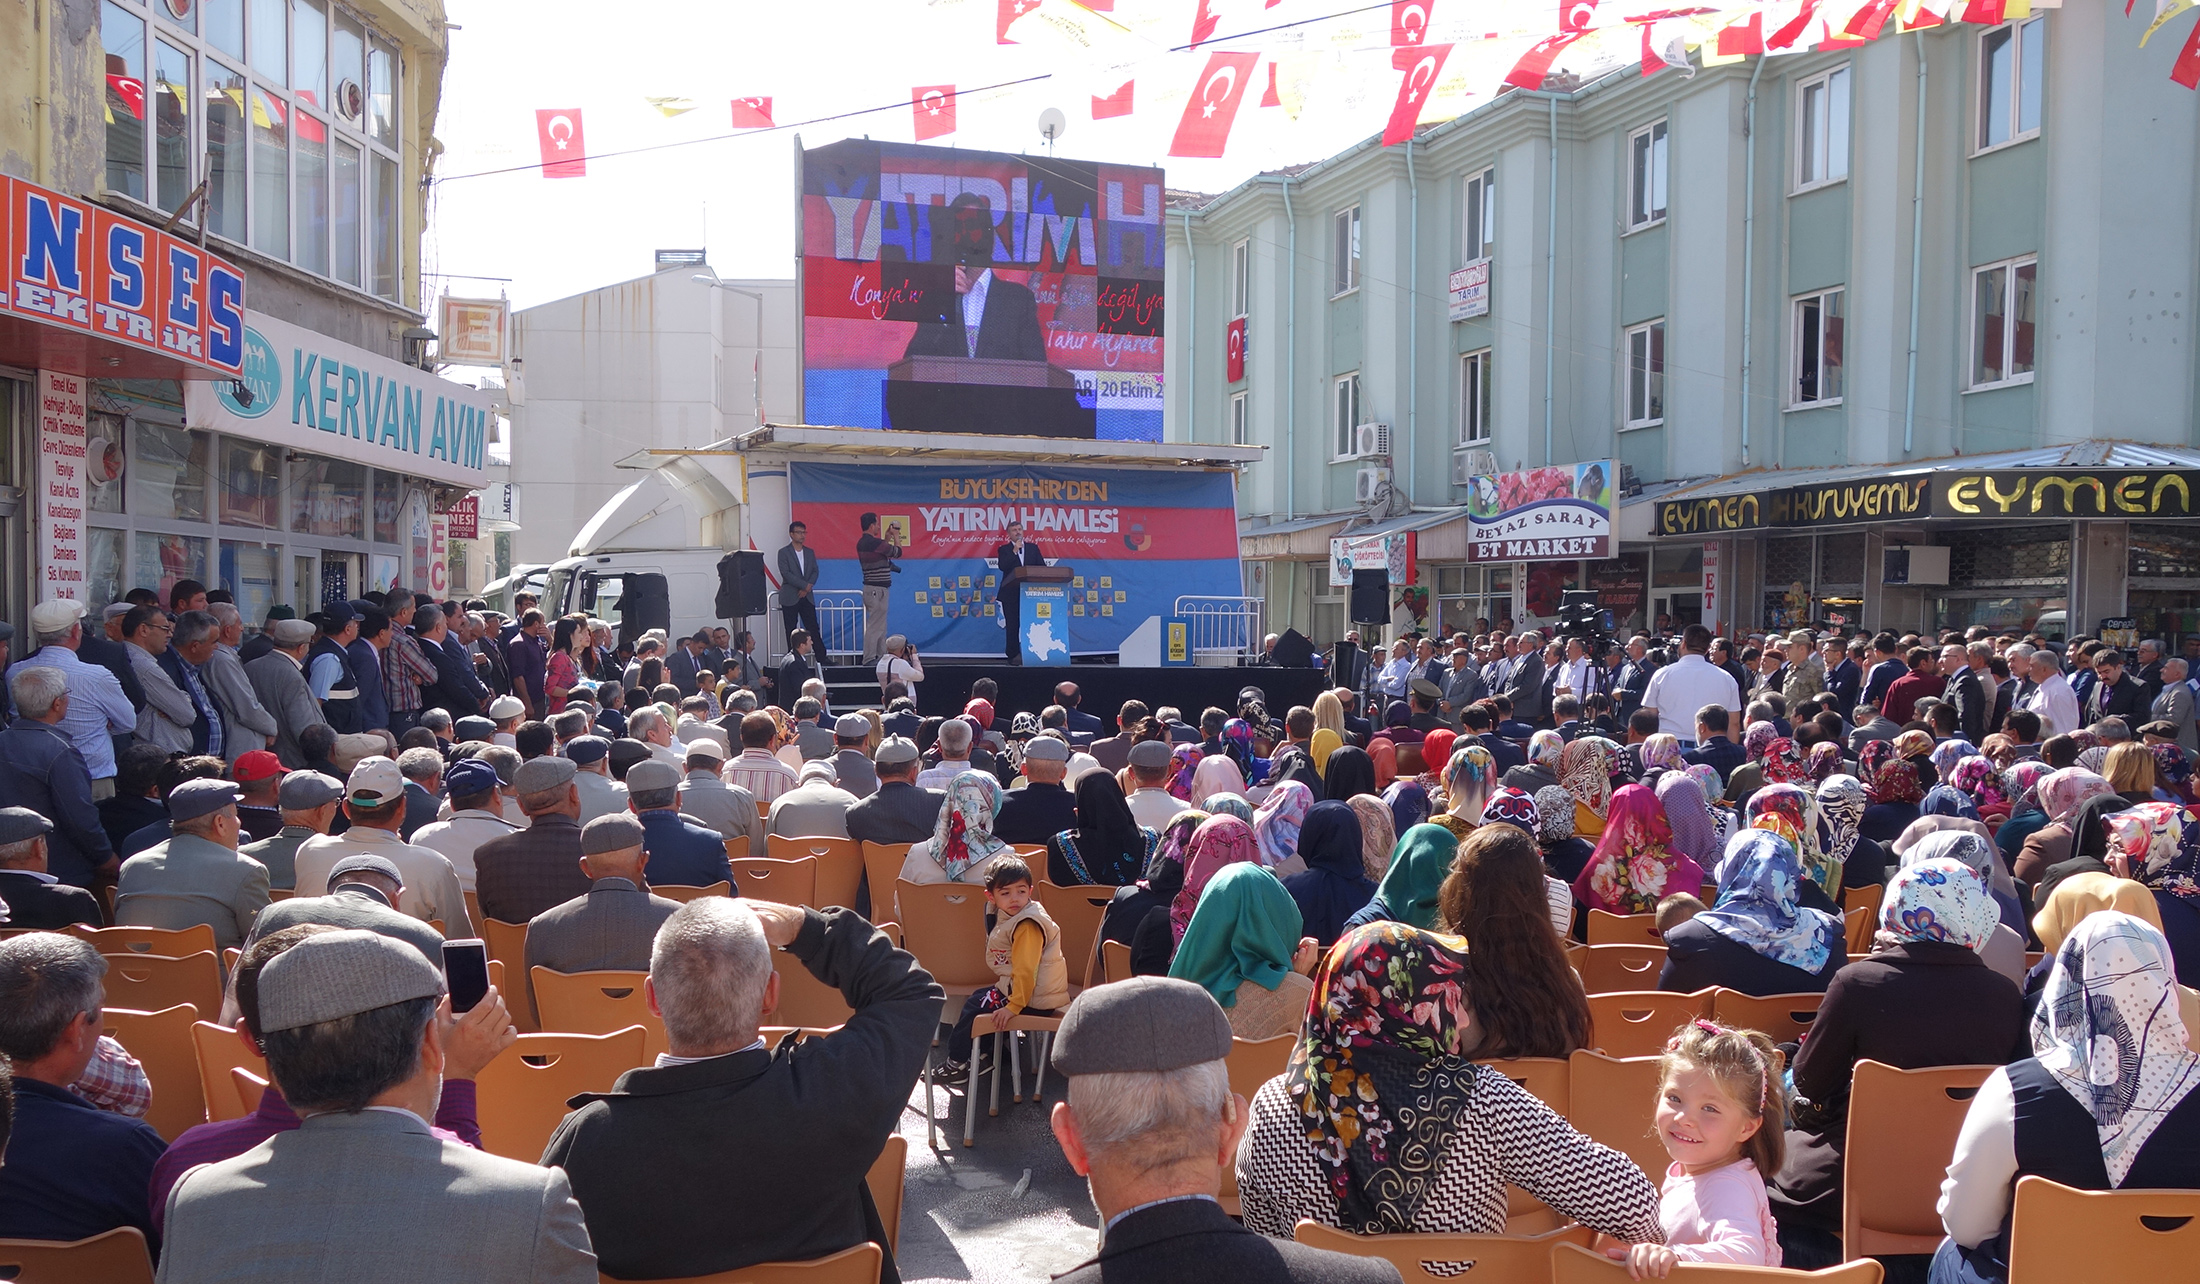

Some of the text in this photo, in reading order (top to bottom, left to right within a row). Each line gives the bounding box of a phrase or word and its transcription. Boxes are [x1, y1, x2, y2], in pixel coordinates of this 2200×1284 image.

[22, 190, 244, 370] NSES
[1457, 287, 1480, 301] TARIM
[1046, 319, 1088, 349] Tahir
[49, 375, 66, 394] Temel
[1101, 381, 1118, 398] 20
[1120, 381, 1153, 399] Ekim
[43, 395, 66, 416] Hafriyat
[68, 399, 84, 420] Dolgu
[292, 347, 486, 471] KERVAN AVM
[43, 416, 85, 438] Çiftlik Temizleme
[42, 437, 86, 459] Çevre Düzenleme
[54, 460, 75, 481] Tesviye
[49, 480, 80, 501] Kanal Açma
[1948, 473, 2190, 514] EYMEN
[47, 501, 82, 523] Kanalizasyon
[918, 506, 1017, 532] YATIRIM
[1663, 494, 1760, 534] EYMEN
[53, 523, 76, 543] Bağlama
[1475, 511, 1601, 540] BEYAZ SARAY
[53, 544, 77, 561] Damlama
[1477, 537, 1597, 559] ET MARKET
[58, 566, 83, 582] Kurulumu
